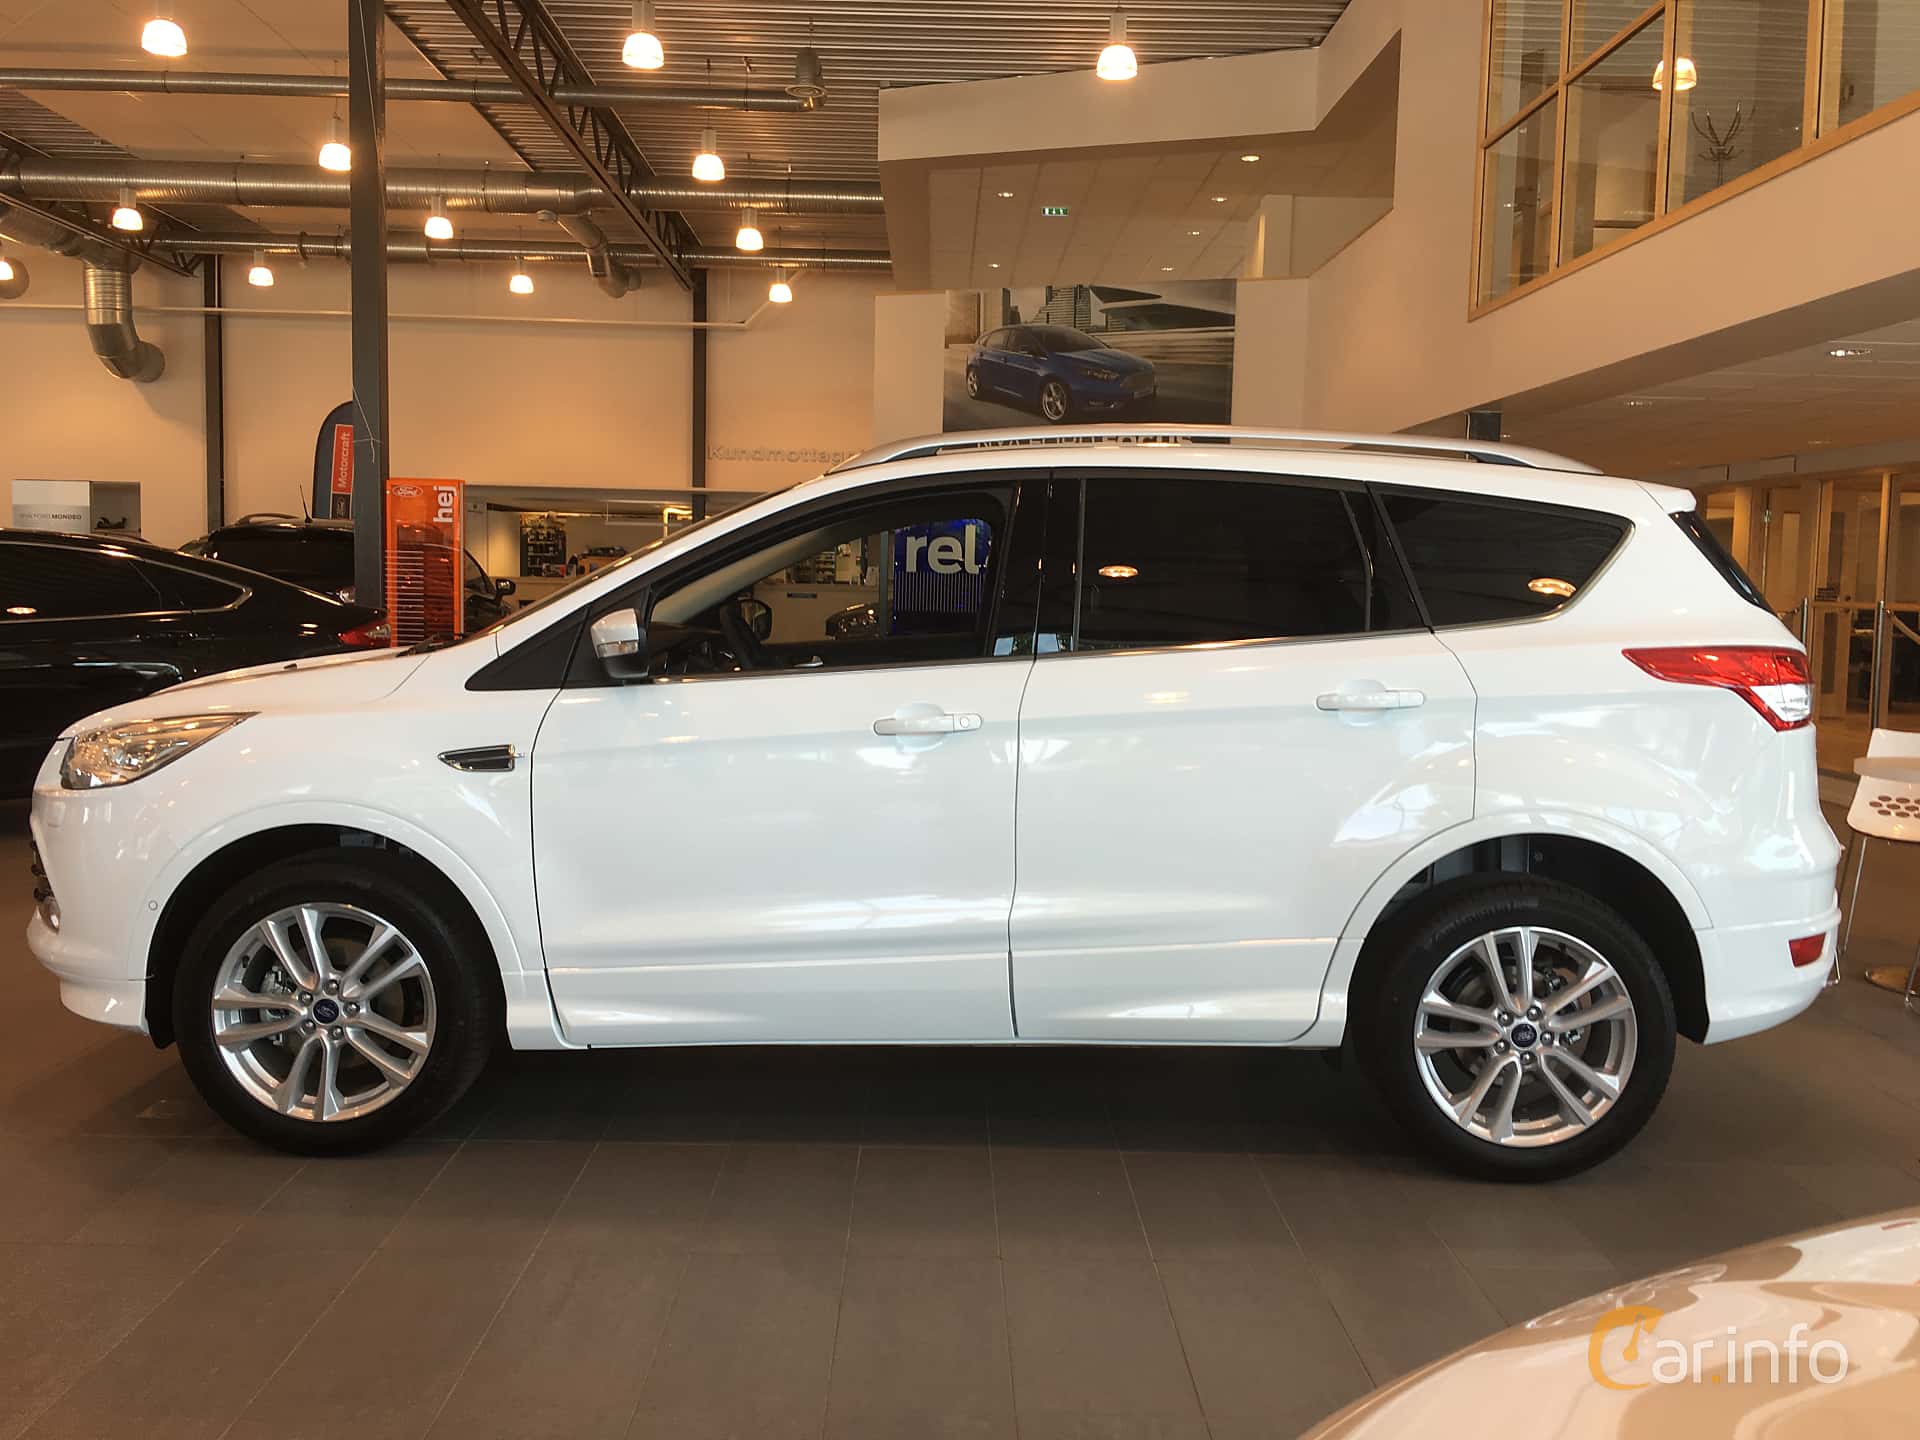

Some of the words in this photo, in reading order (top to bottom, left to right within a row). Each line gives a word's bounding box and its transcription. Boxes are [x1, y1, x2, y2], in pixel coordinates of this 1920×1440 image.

[337, 431, 351, 489] Motorcraft
[432, 485, 457, 523] hej
[906, 523, 980, 575] rel
